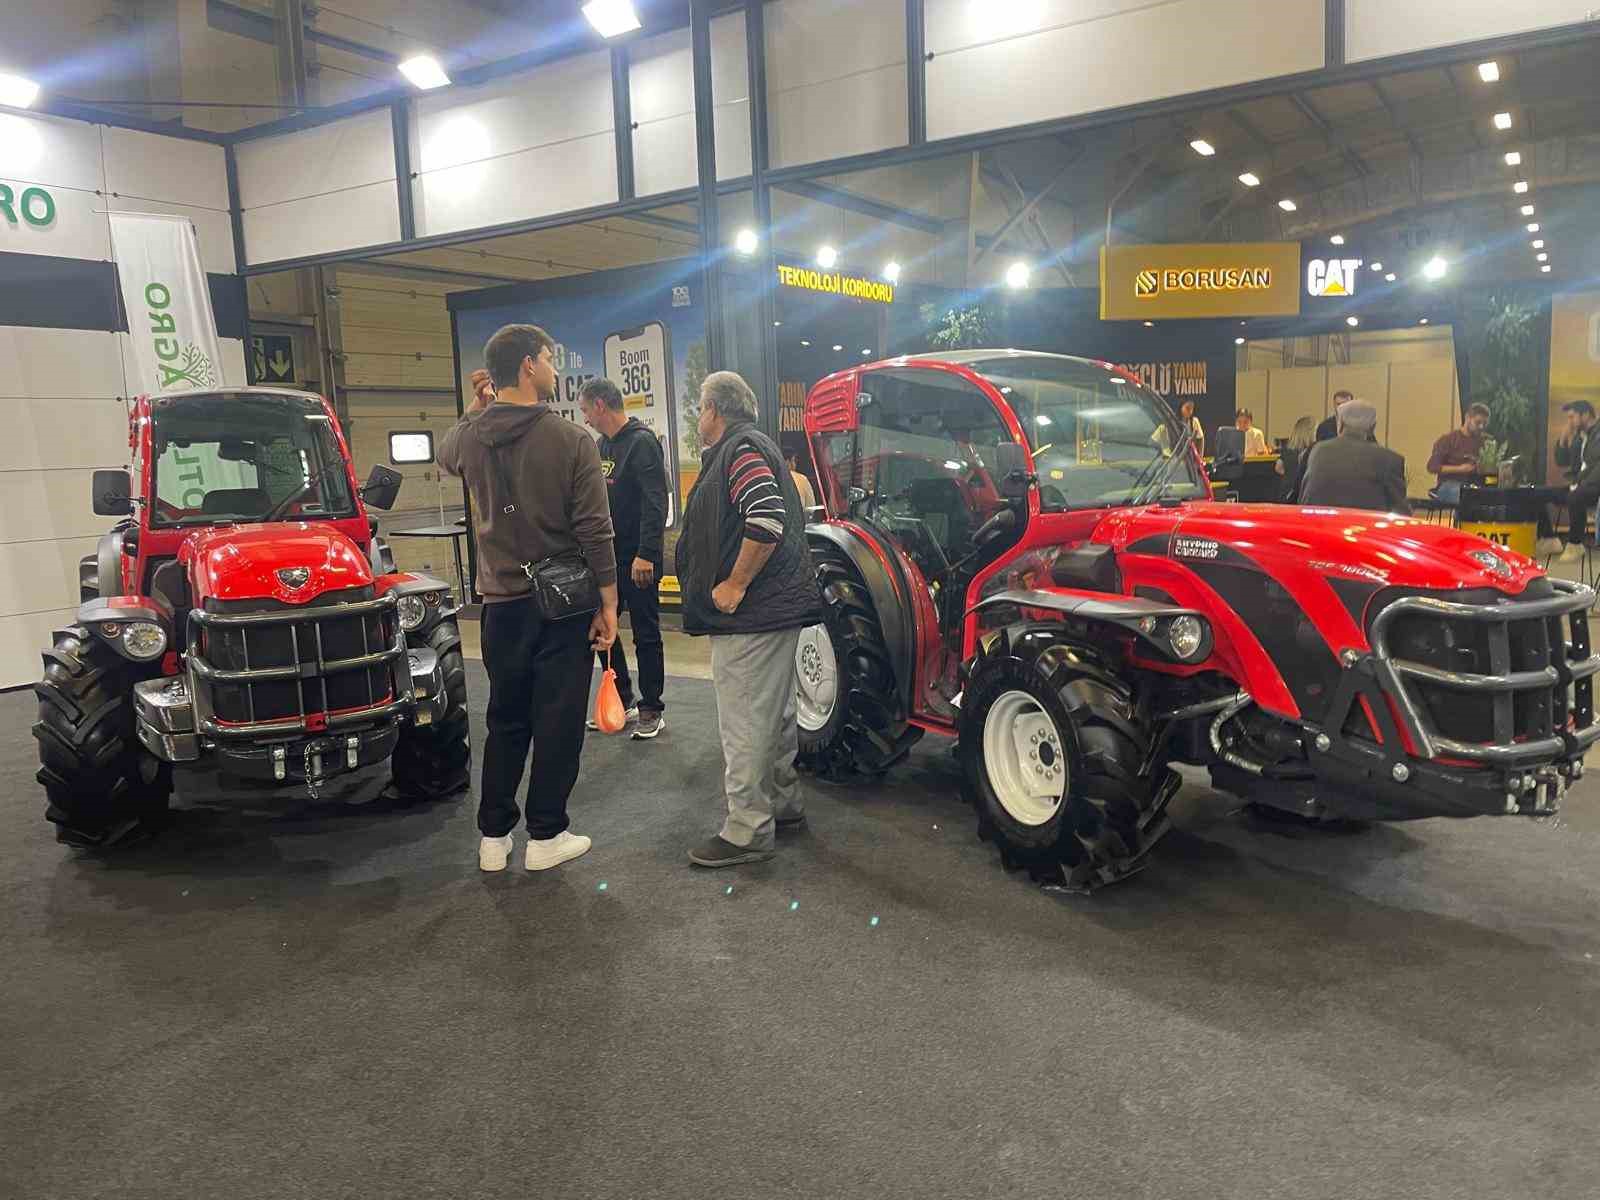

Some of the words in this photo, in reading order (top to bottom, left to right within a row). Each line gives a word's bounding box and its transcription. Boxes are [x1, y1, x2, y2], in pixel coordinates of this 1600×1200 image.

[1164, 268, 1271, 290] BORUSAN
[1308, 258, 1361, 296] CAT
[620, 349, 649, 366] Boom
[621, 363, 651, 396] 360
